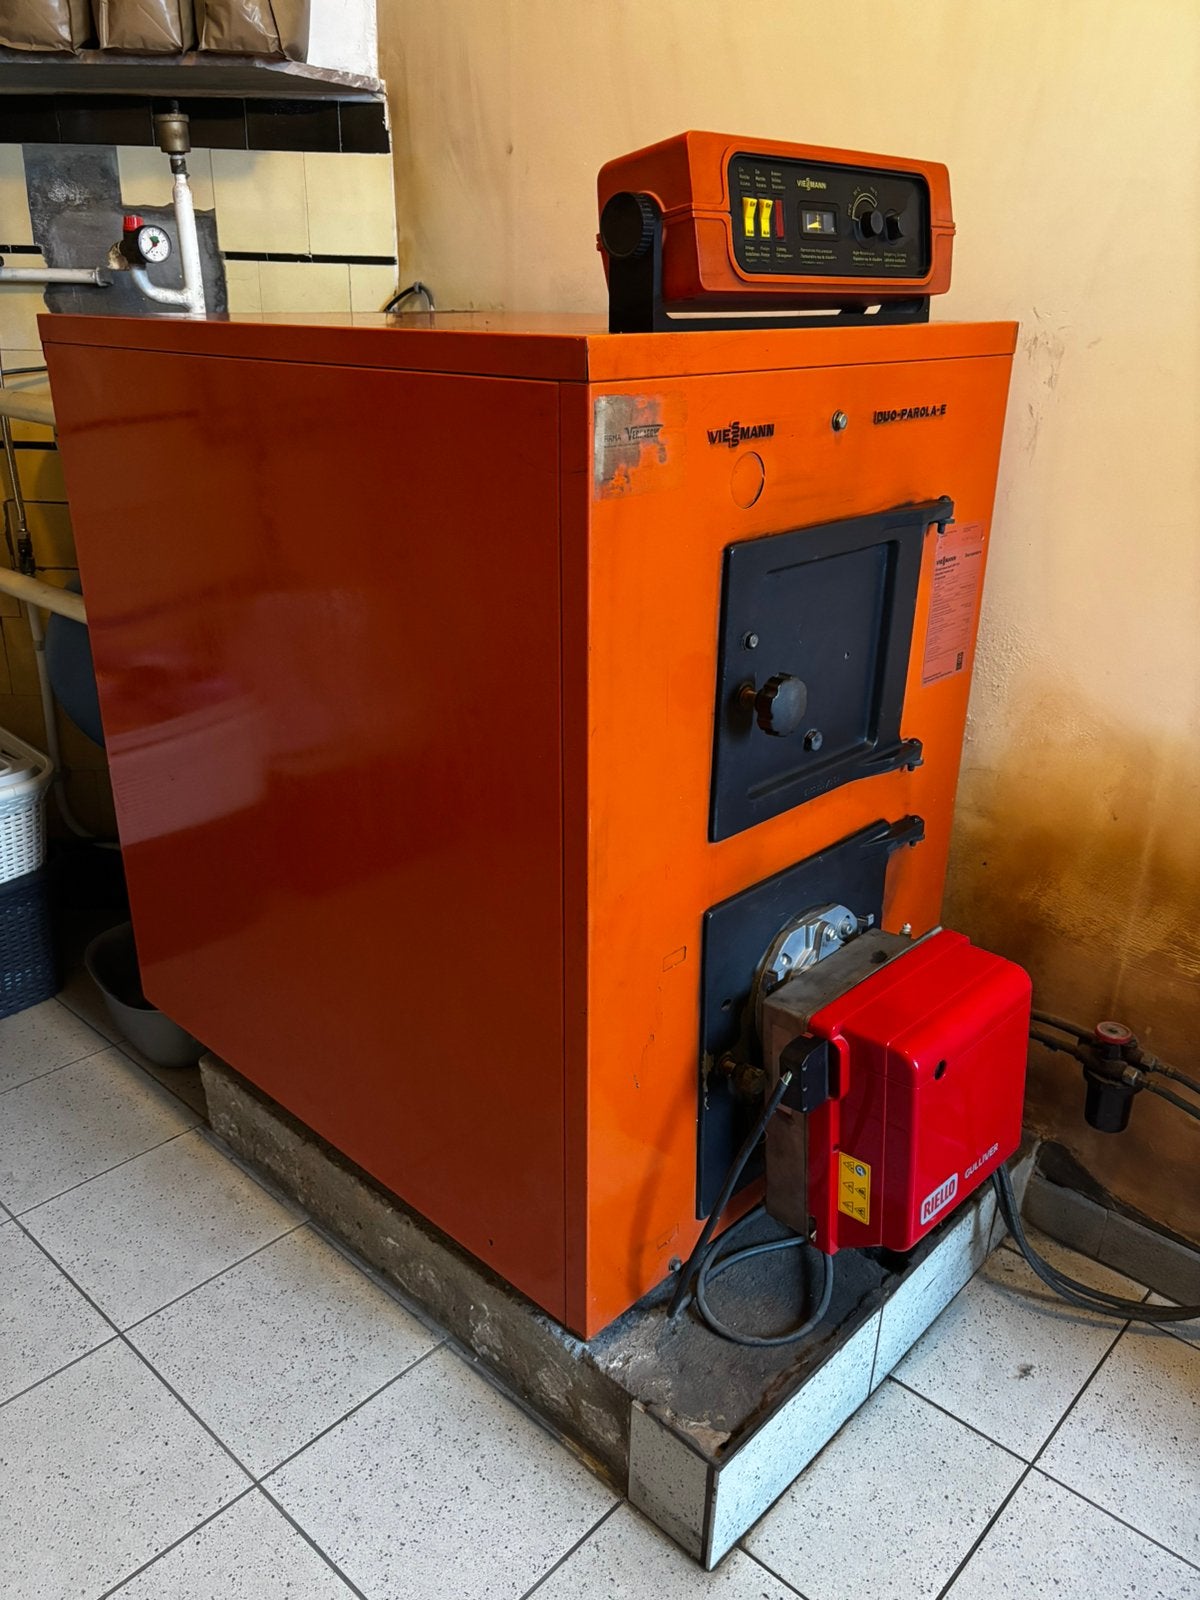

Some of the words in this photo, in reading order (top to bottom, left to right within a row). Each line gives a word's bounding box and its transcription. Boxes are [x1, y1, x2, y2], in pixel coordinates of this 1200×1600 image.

[796, 177, 827, 191] VIESSMANN
[874, 404, 947, 425] DUO-PAROLA-E
[707, 421, 775, 448] VIESSMANN
[964, 1142, 999, 1179] GULLIVER
[924, 1178, 956, 1219] RIELLO
